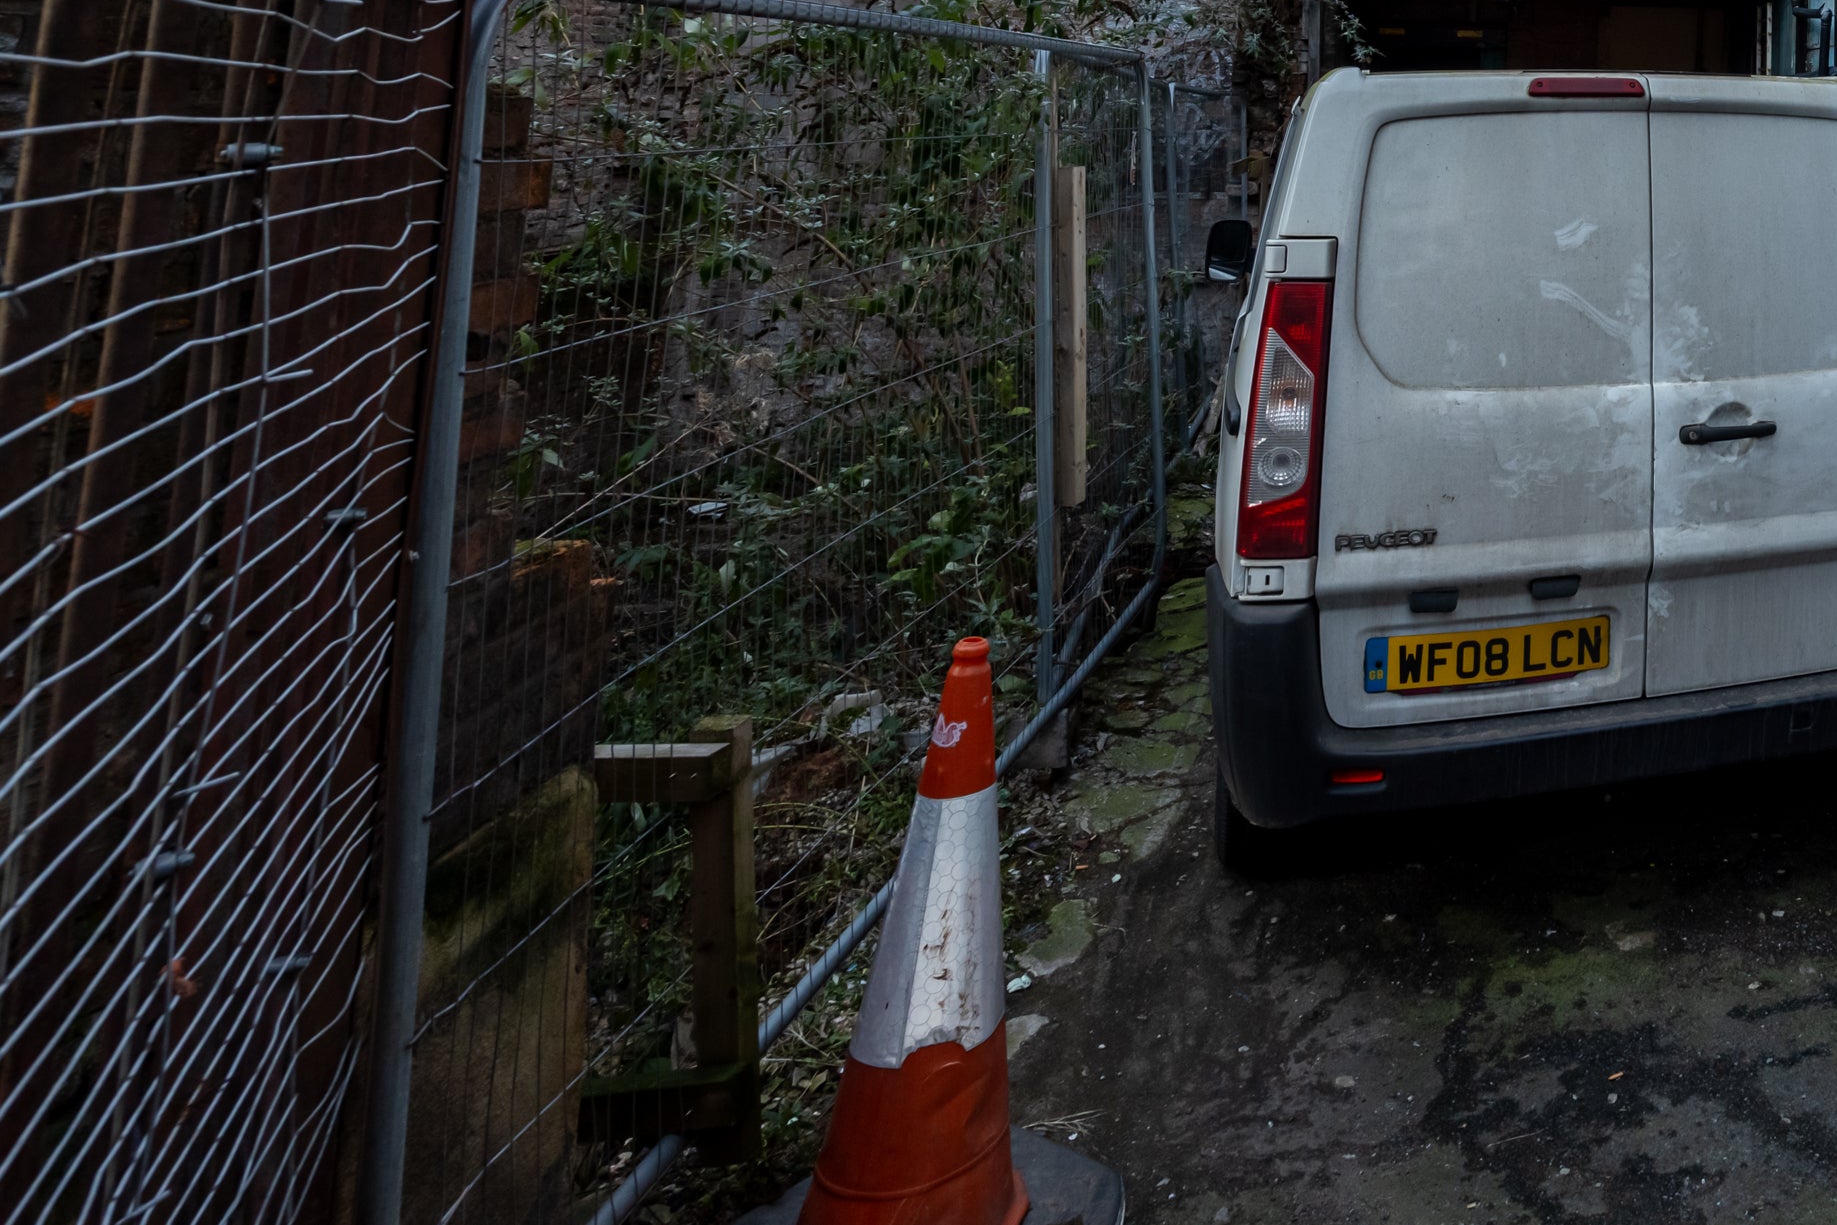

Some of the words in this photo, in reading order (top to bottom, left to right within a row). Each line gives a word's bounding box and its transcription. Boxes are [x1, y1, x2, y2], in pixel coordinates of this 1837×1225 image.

[1335, 529, 1437, 552] PEUGEOT
[1399, 638, 1509, 684] WF08
[1523, 626, 1602, 673] LCN
[1369, 669, 1383, 681] GB
